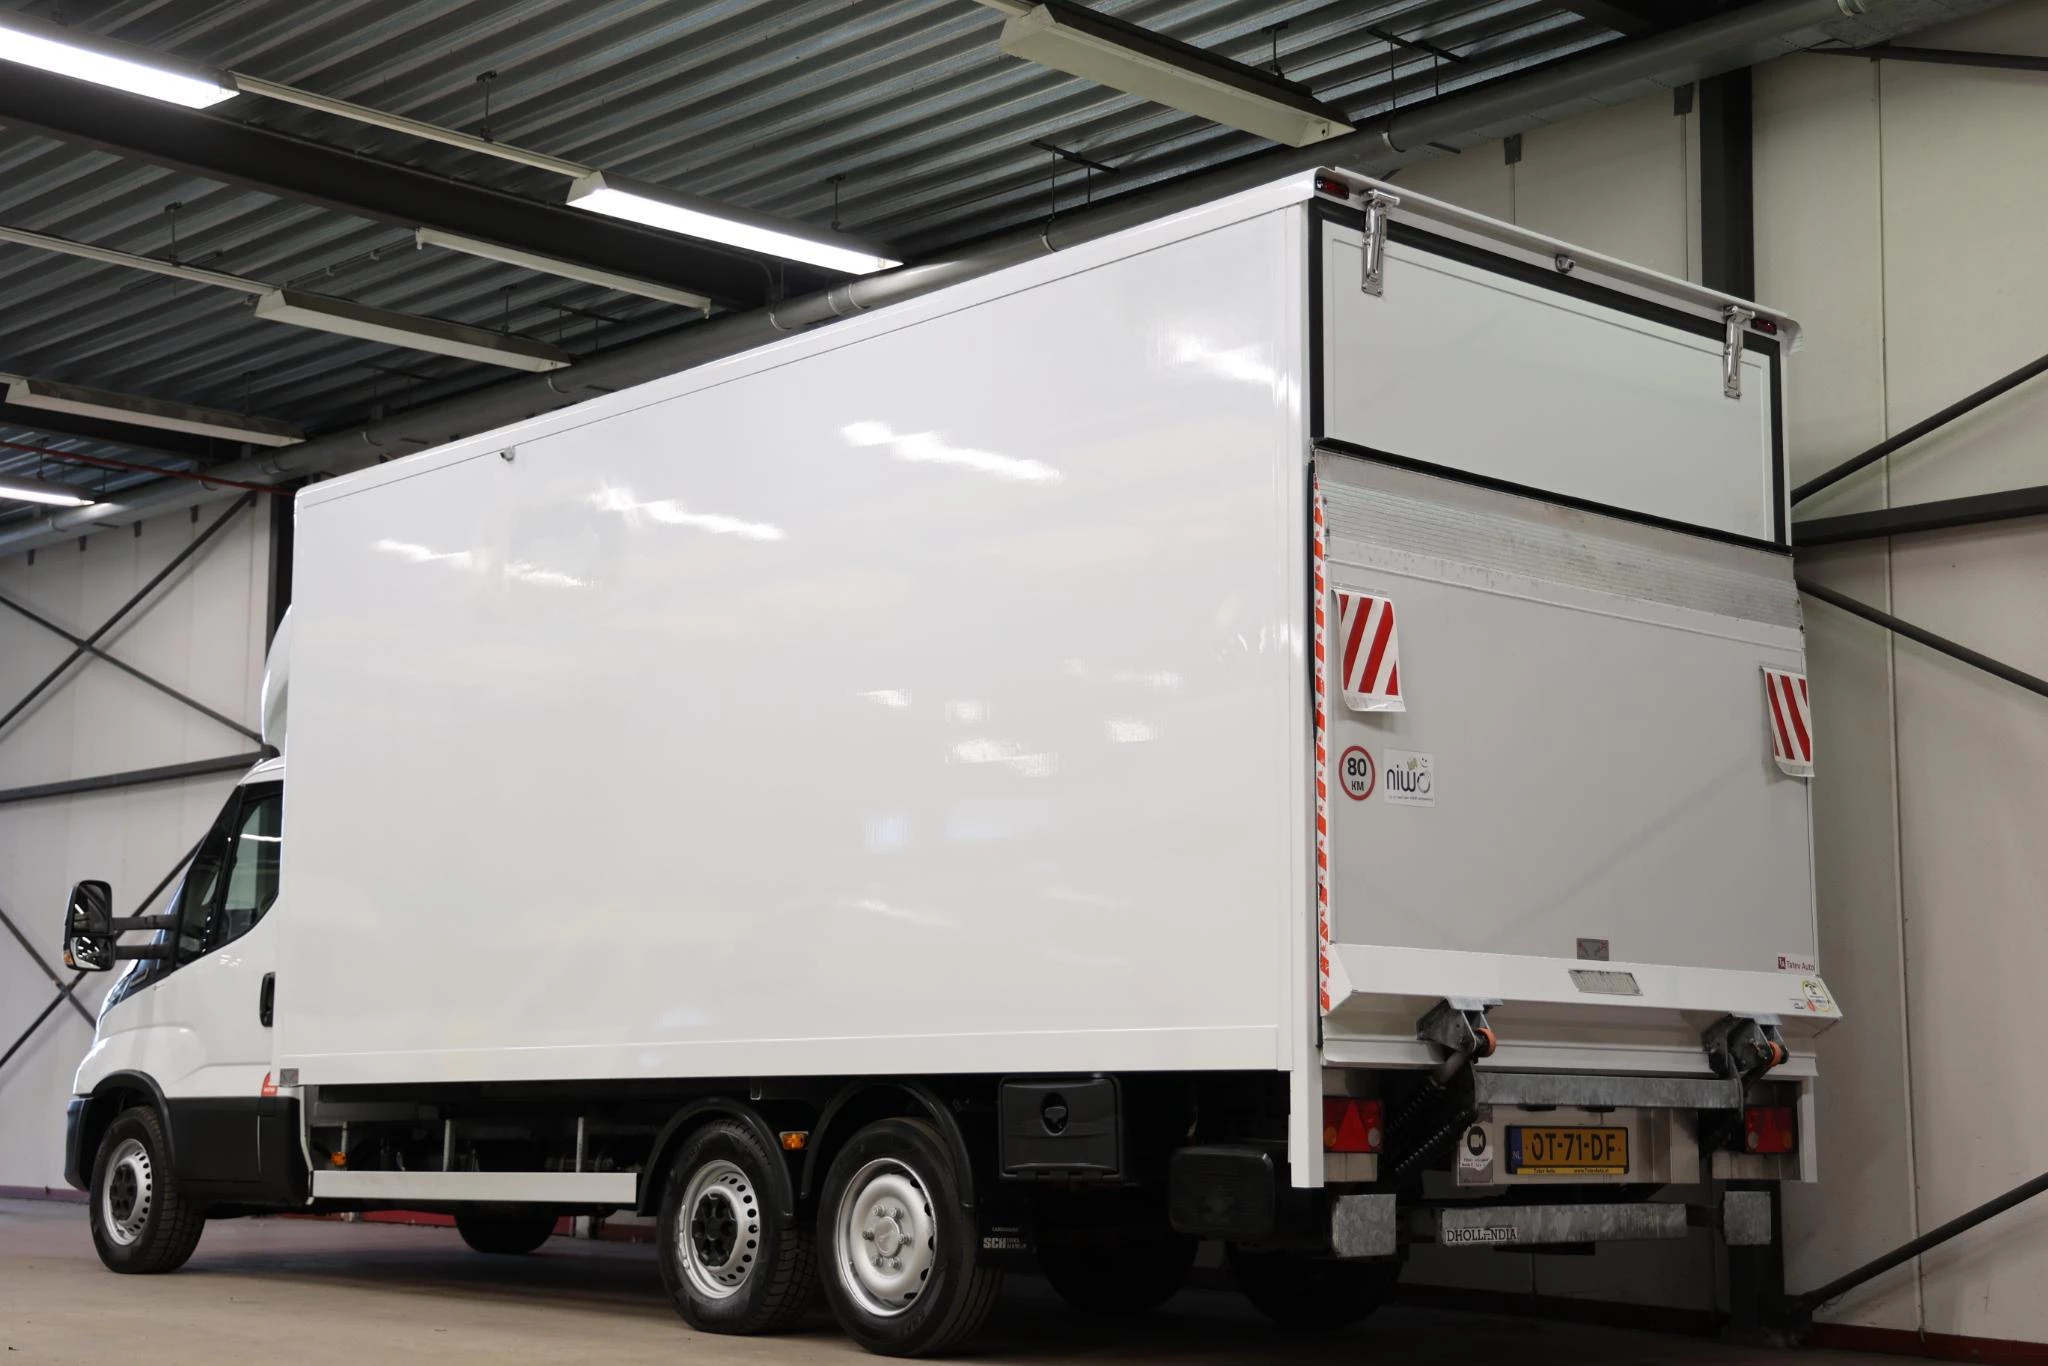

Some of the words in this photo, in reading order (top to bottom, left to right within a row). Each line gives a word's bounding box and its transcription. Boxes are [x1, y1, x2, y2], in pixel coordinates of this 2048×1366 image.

[1347, 757, 1367, 777] 80
[1351, 780, 1365, 791] KM
[1531, 1132, 1615, 1161] OT-71-DF
[1511, 1150, 1522, 1160] NL
